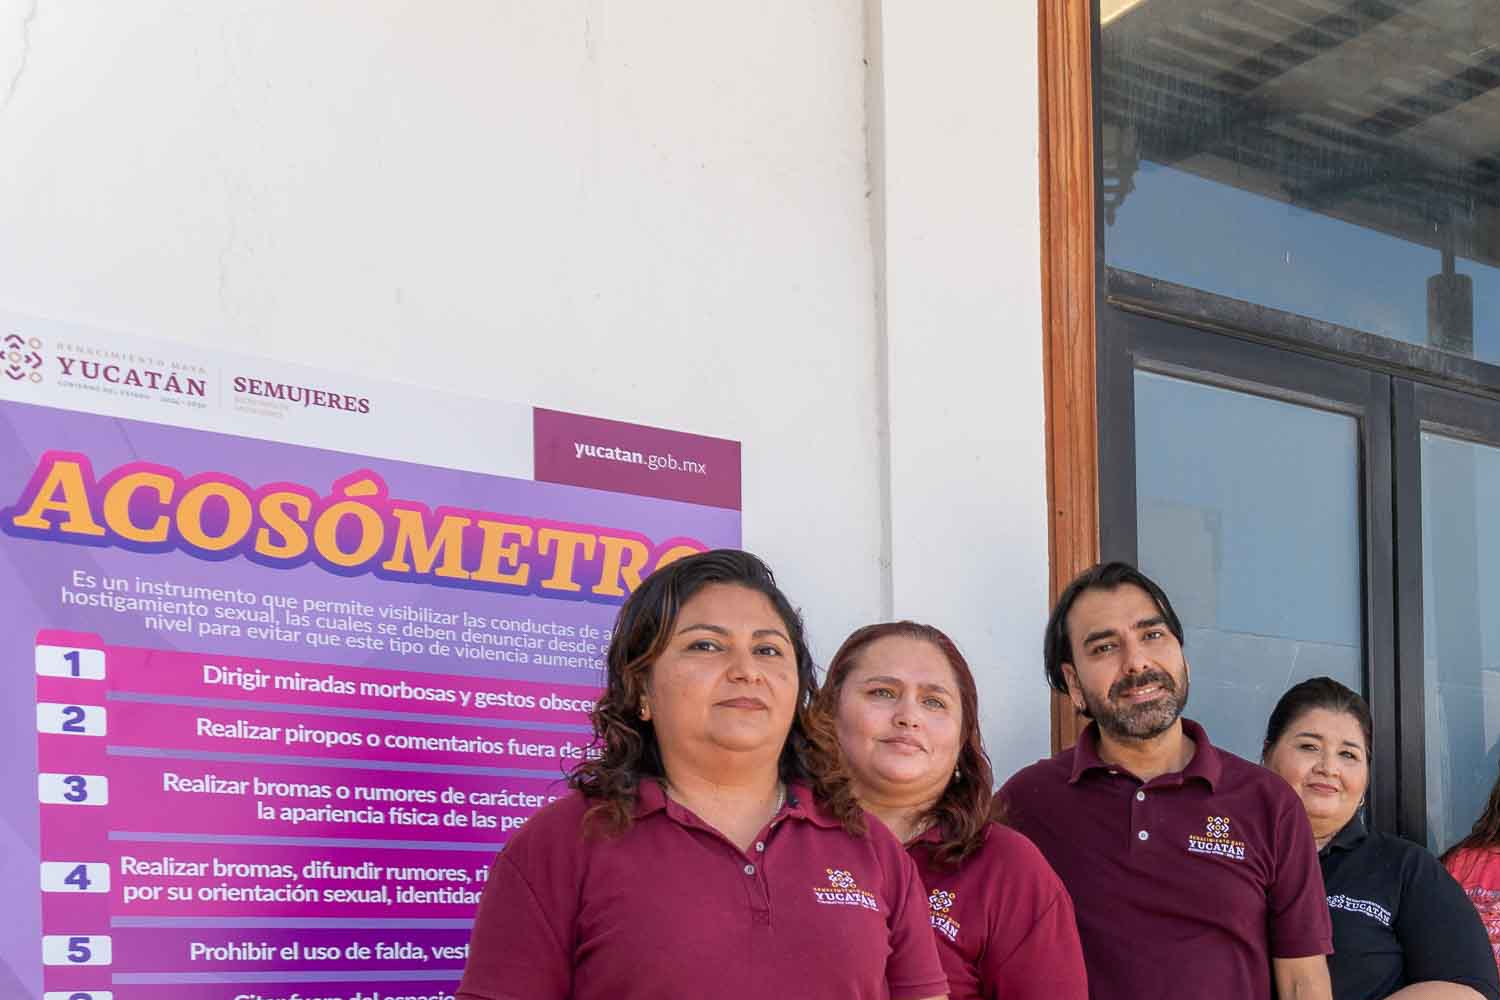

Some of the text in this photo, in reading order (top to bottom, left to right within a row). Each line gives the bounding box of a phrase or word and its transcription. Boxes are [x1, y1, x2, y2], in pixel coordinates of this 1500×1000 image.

[56, 355, 207, 397] YUCATÁN
[233, 376, 370, 414] SEMUJERES
[574, 440, 707, 475] yucatan.gob.mx
[72, 569, 97, 588] Es
[136, 576, 257, 606] instrumento
[262, 592, 298, 615] que
[303, 594, 374, 619] permite
[378, 604, 460, 626] visibilizar
[463, 611, 486, 628] las
[490, 615, 576, 638] conductas
[61, 586, 208, 618] hostigamiento
[215, 602, 280, 626] sexual,
[286, 608, 310, 627] las
[315, 615, 373, 634] cuales
[402, 621, 457, 642] deben
[461, 629, 545, 650] denunciar
[547, 635, 598, 655] desde
[145, 613, 192, 633] nivel
[199, 621, 242, 639] para
[247, 623, 301, 643] evitar
[306, 632, 341, 650] que
[346, 636, 385, 651] este
[389, 638, 424, 658] tipo
[454, 644, 529, 665] violencia
[63, 651, 81, 677] 1
[202, 664, 535, 711] Dirigir miradas morbosas gestos
[61, 705, 86, 733] 2
[196, 717, 555, 759] Realizar piropos comentarios fuera
[63, 775, 88, 803] 3
[163, 772, 545, 807] Realizar bromas rumores carácter
[279, 803, 385, 825] apariencia
[388, 807, 439, 827] física
[472, 809, 497, 828] las
[64, 864, 92, 891] 4
[120, 856, 209, 878] Realizar
[213, 858, 298, 881] bromas,
[302, 860, 384, 881] difundir
[386, 866, 471, 884] rumores,
[123, 883, 393, 906] por orientación sexual,
[66, 936, 92, 963] 5
[190, 941, 429, 963] Prohibir uso falda,
